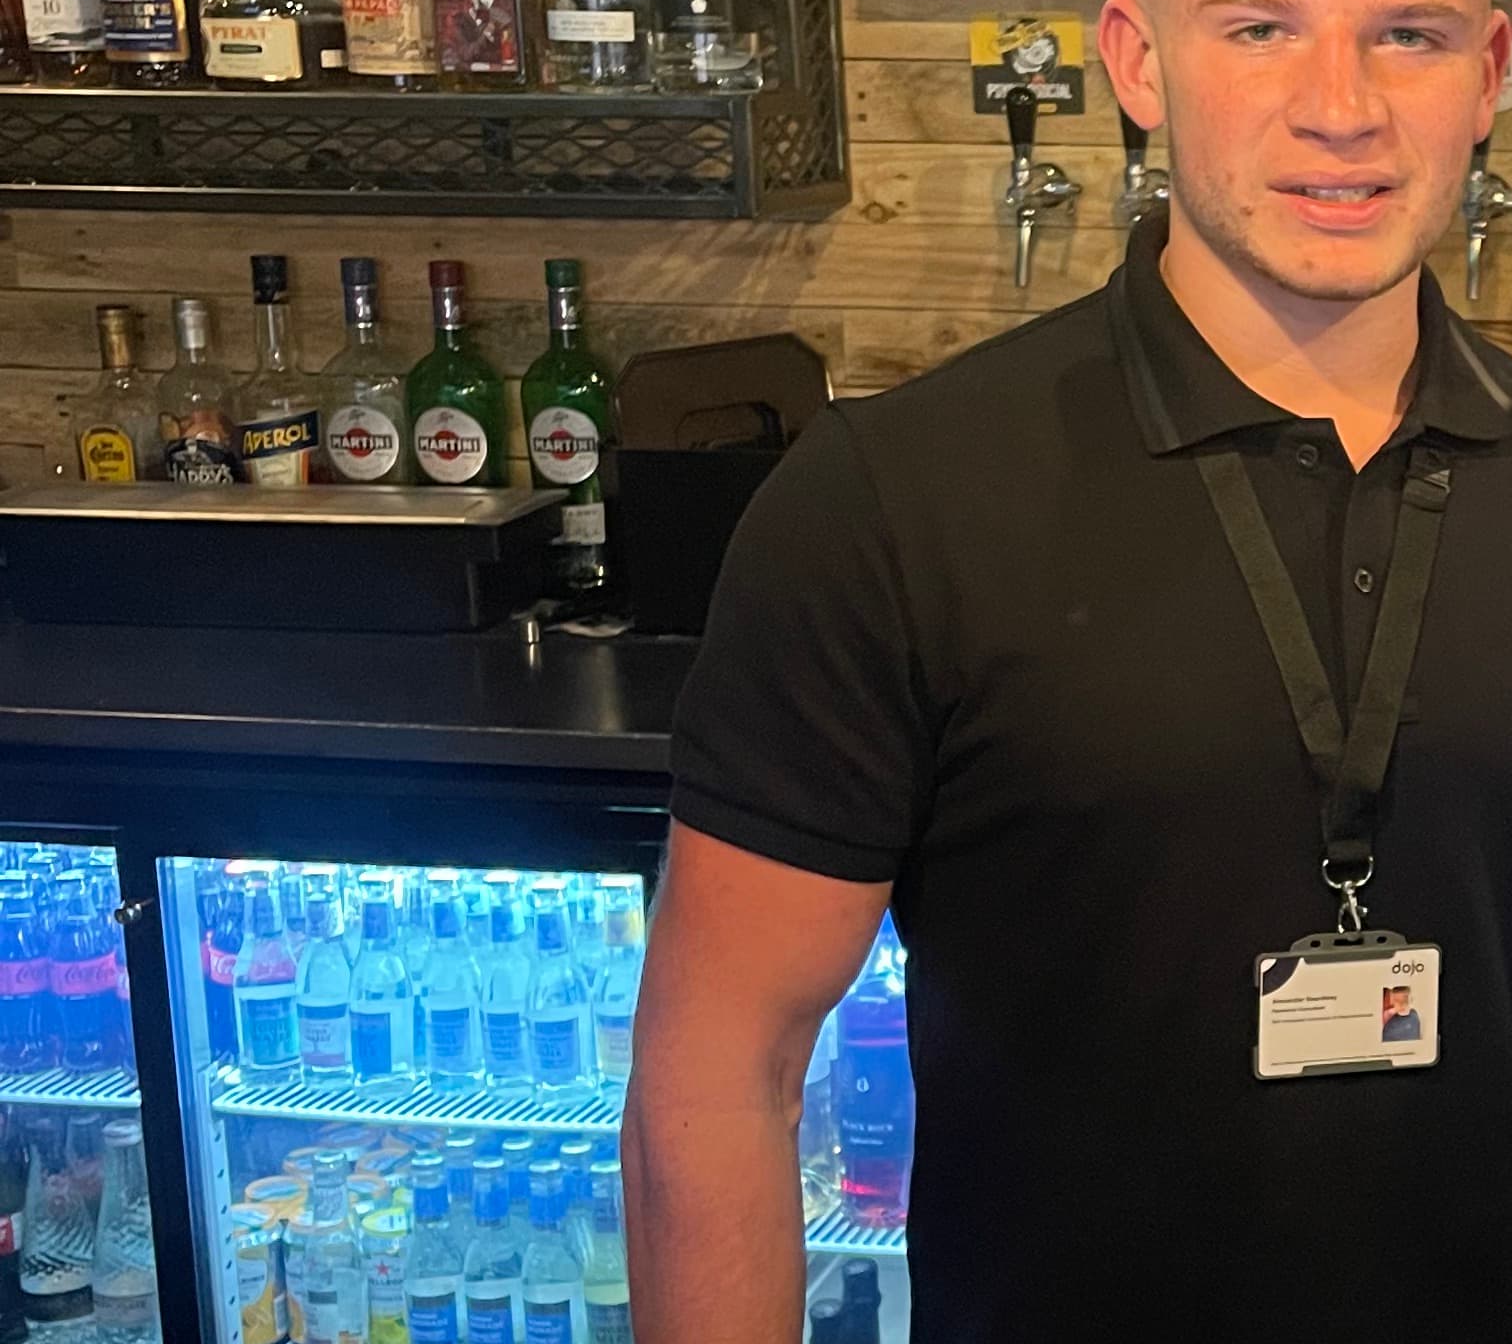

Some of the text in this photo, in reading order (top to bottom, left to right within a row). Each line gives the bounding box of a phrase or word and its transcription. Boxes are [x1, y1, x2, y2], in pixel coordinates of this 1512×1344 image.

[243, 420, 312, 453] APEROL
[331, 433, 393, 450] MARTINI
[419, 436, 480, 453] MARTINI
[533, 436, 596, 453] MARTINI
[1392, 960, 1424, 976] dojo
